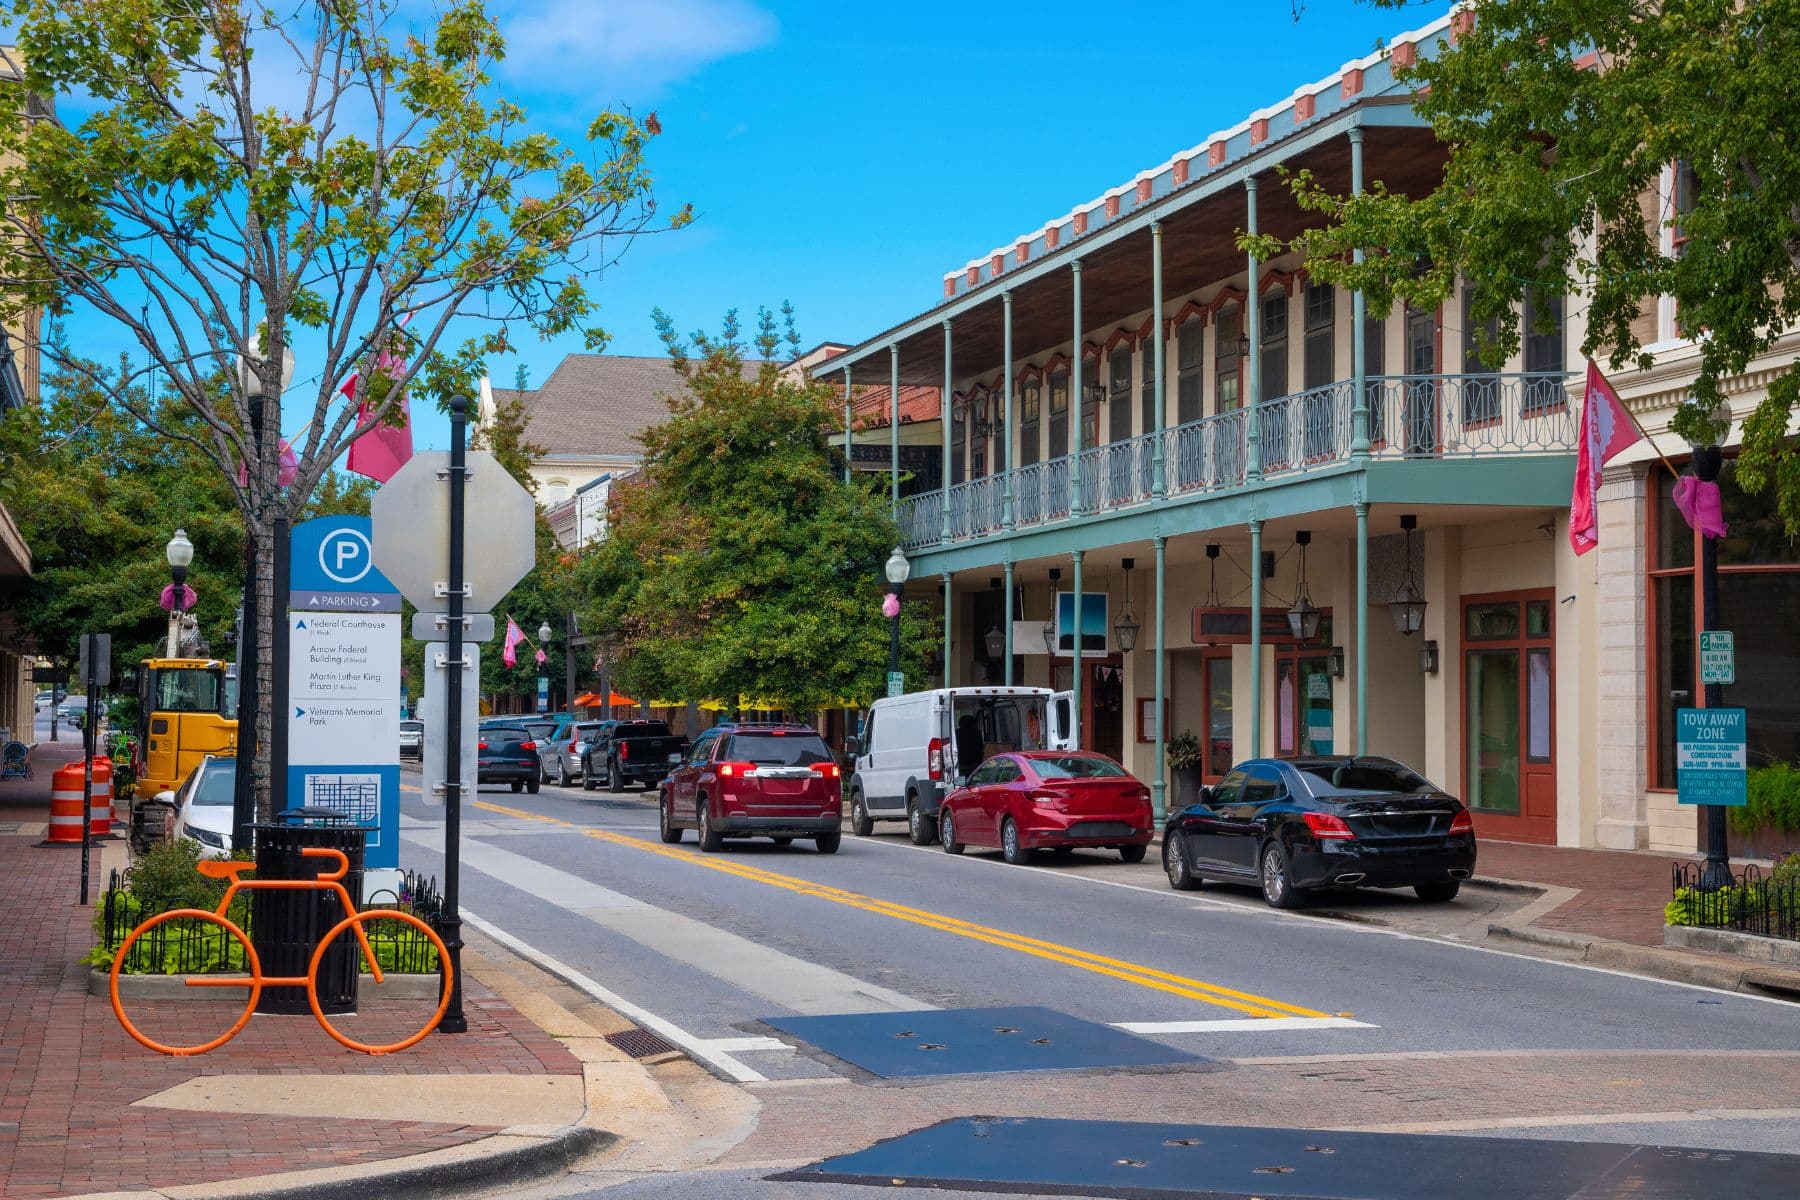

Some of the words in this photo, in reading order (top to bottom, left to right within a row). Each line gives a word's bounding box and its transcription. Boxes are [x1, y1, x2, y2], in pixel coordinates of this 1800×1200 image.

[321, 596, 369, 607] PARKING
[310, 619, 339, 628] Federal
[341, 619, 386, 629] Courthouse
[1701, 635, 1710, 649] 2
[338, 644, 368, 653] Federal
[310, 654, 342, 664] Building
[310, 672, 336, 680] Martin
[338, 672, 361, 680] Luther
[363, 673, 381, 682] King
[309, 681, 332, 690] Plaza
[309, 707, 343, 716] Veterans
[345, 708, 383, 716] Memorial
[309, 717, 327, 725] Park
[1683, 713, 1707, 726] TOW
[1710, 713, 1740, 726] AWAY
[1696, 727, 1726, 740] ZONE
[1717, 744, 1740, 752] DURING
[1690, 751, 1733, 759] CONSTRUCTION
